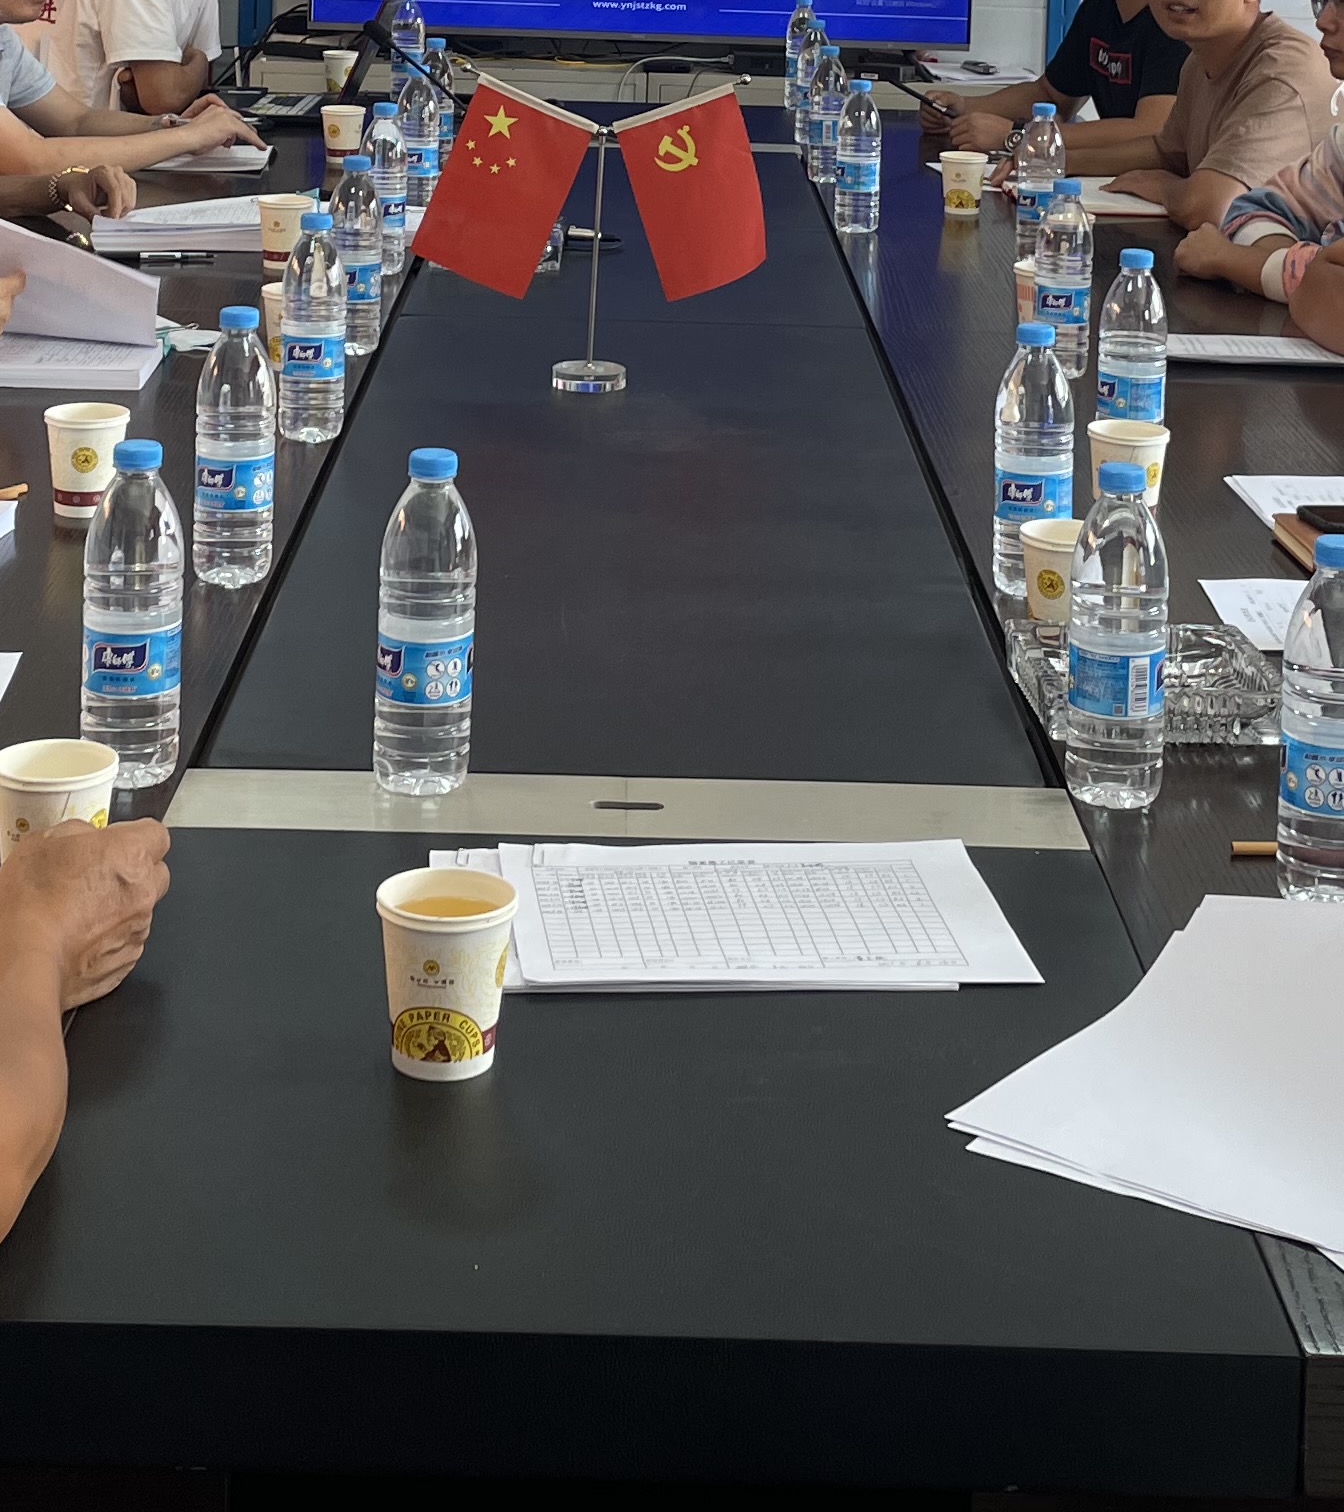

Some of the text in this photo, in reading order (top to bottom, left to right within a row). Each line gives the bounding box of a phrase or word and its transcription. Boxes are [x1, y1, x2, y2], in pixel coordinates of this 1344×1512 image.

[593, 0, 687, 12] www.ynjstzkg.com
[409, 1010, 482, 1048] PAPER CUPS
